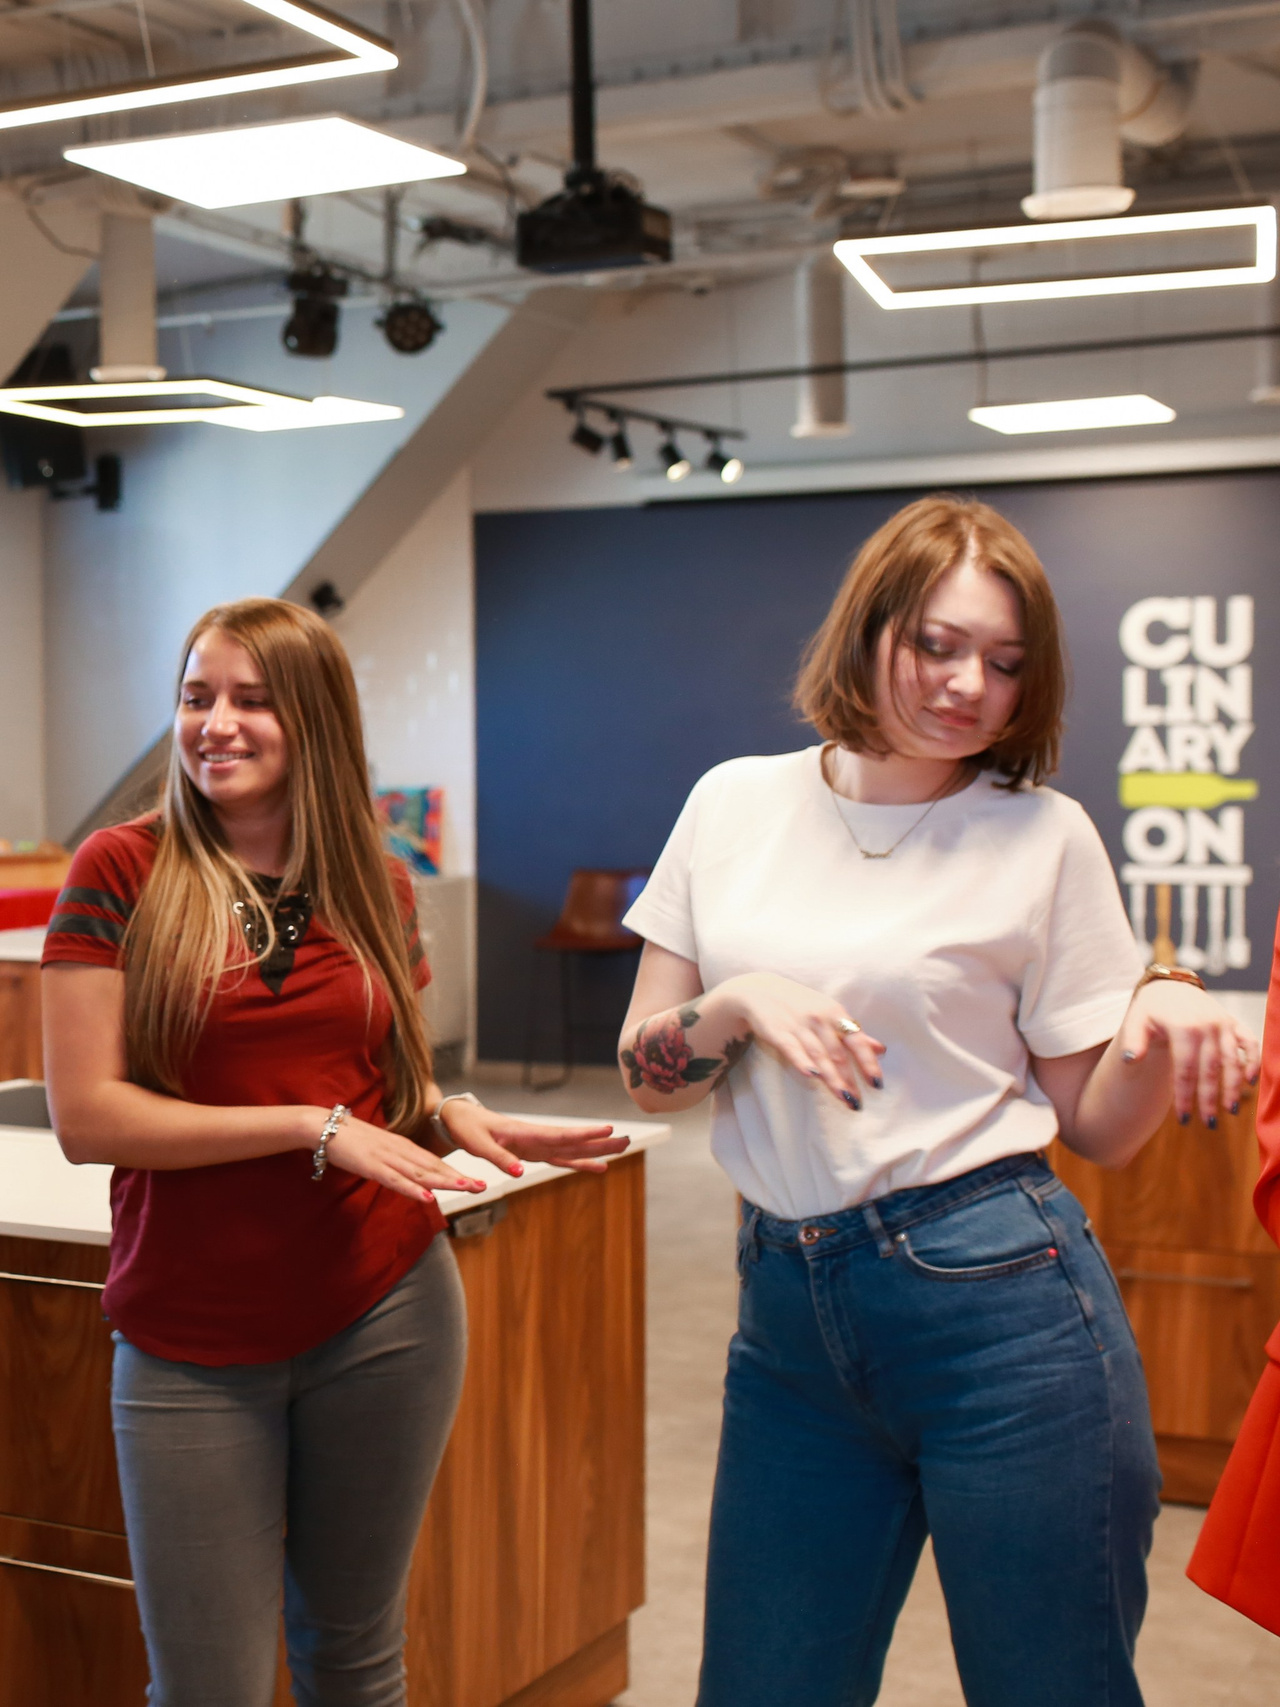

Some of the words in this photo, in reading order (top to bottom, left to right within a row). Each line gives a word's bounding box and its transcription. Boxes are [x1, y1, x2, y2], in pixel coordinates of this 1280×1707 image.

[1119, 594, 1255, 669] CU
[1122, 663, 1253, 726] LIN
[1119, 722, 1256, 774] ARY
[1122, 805, 1245, 866] ON
